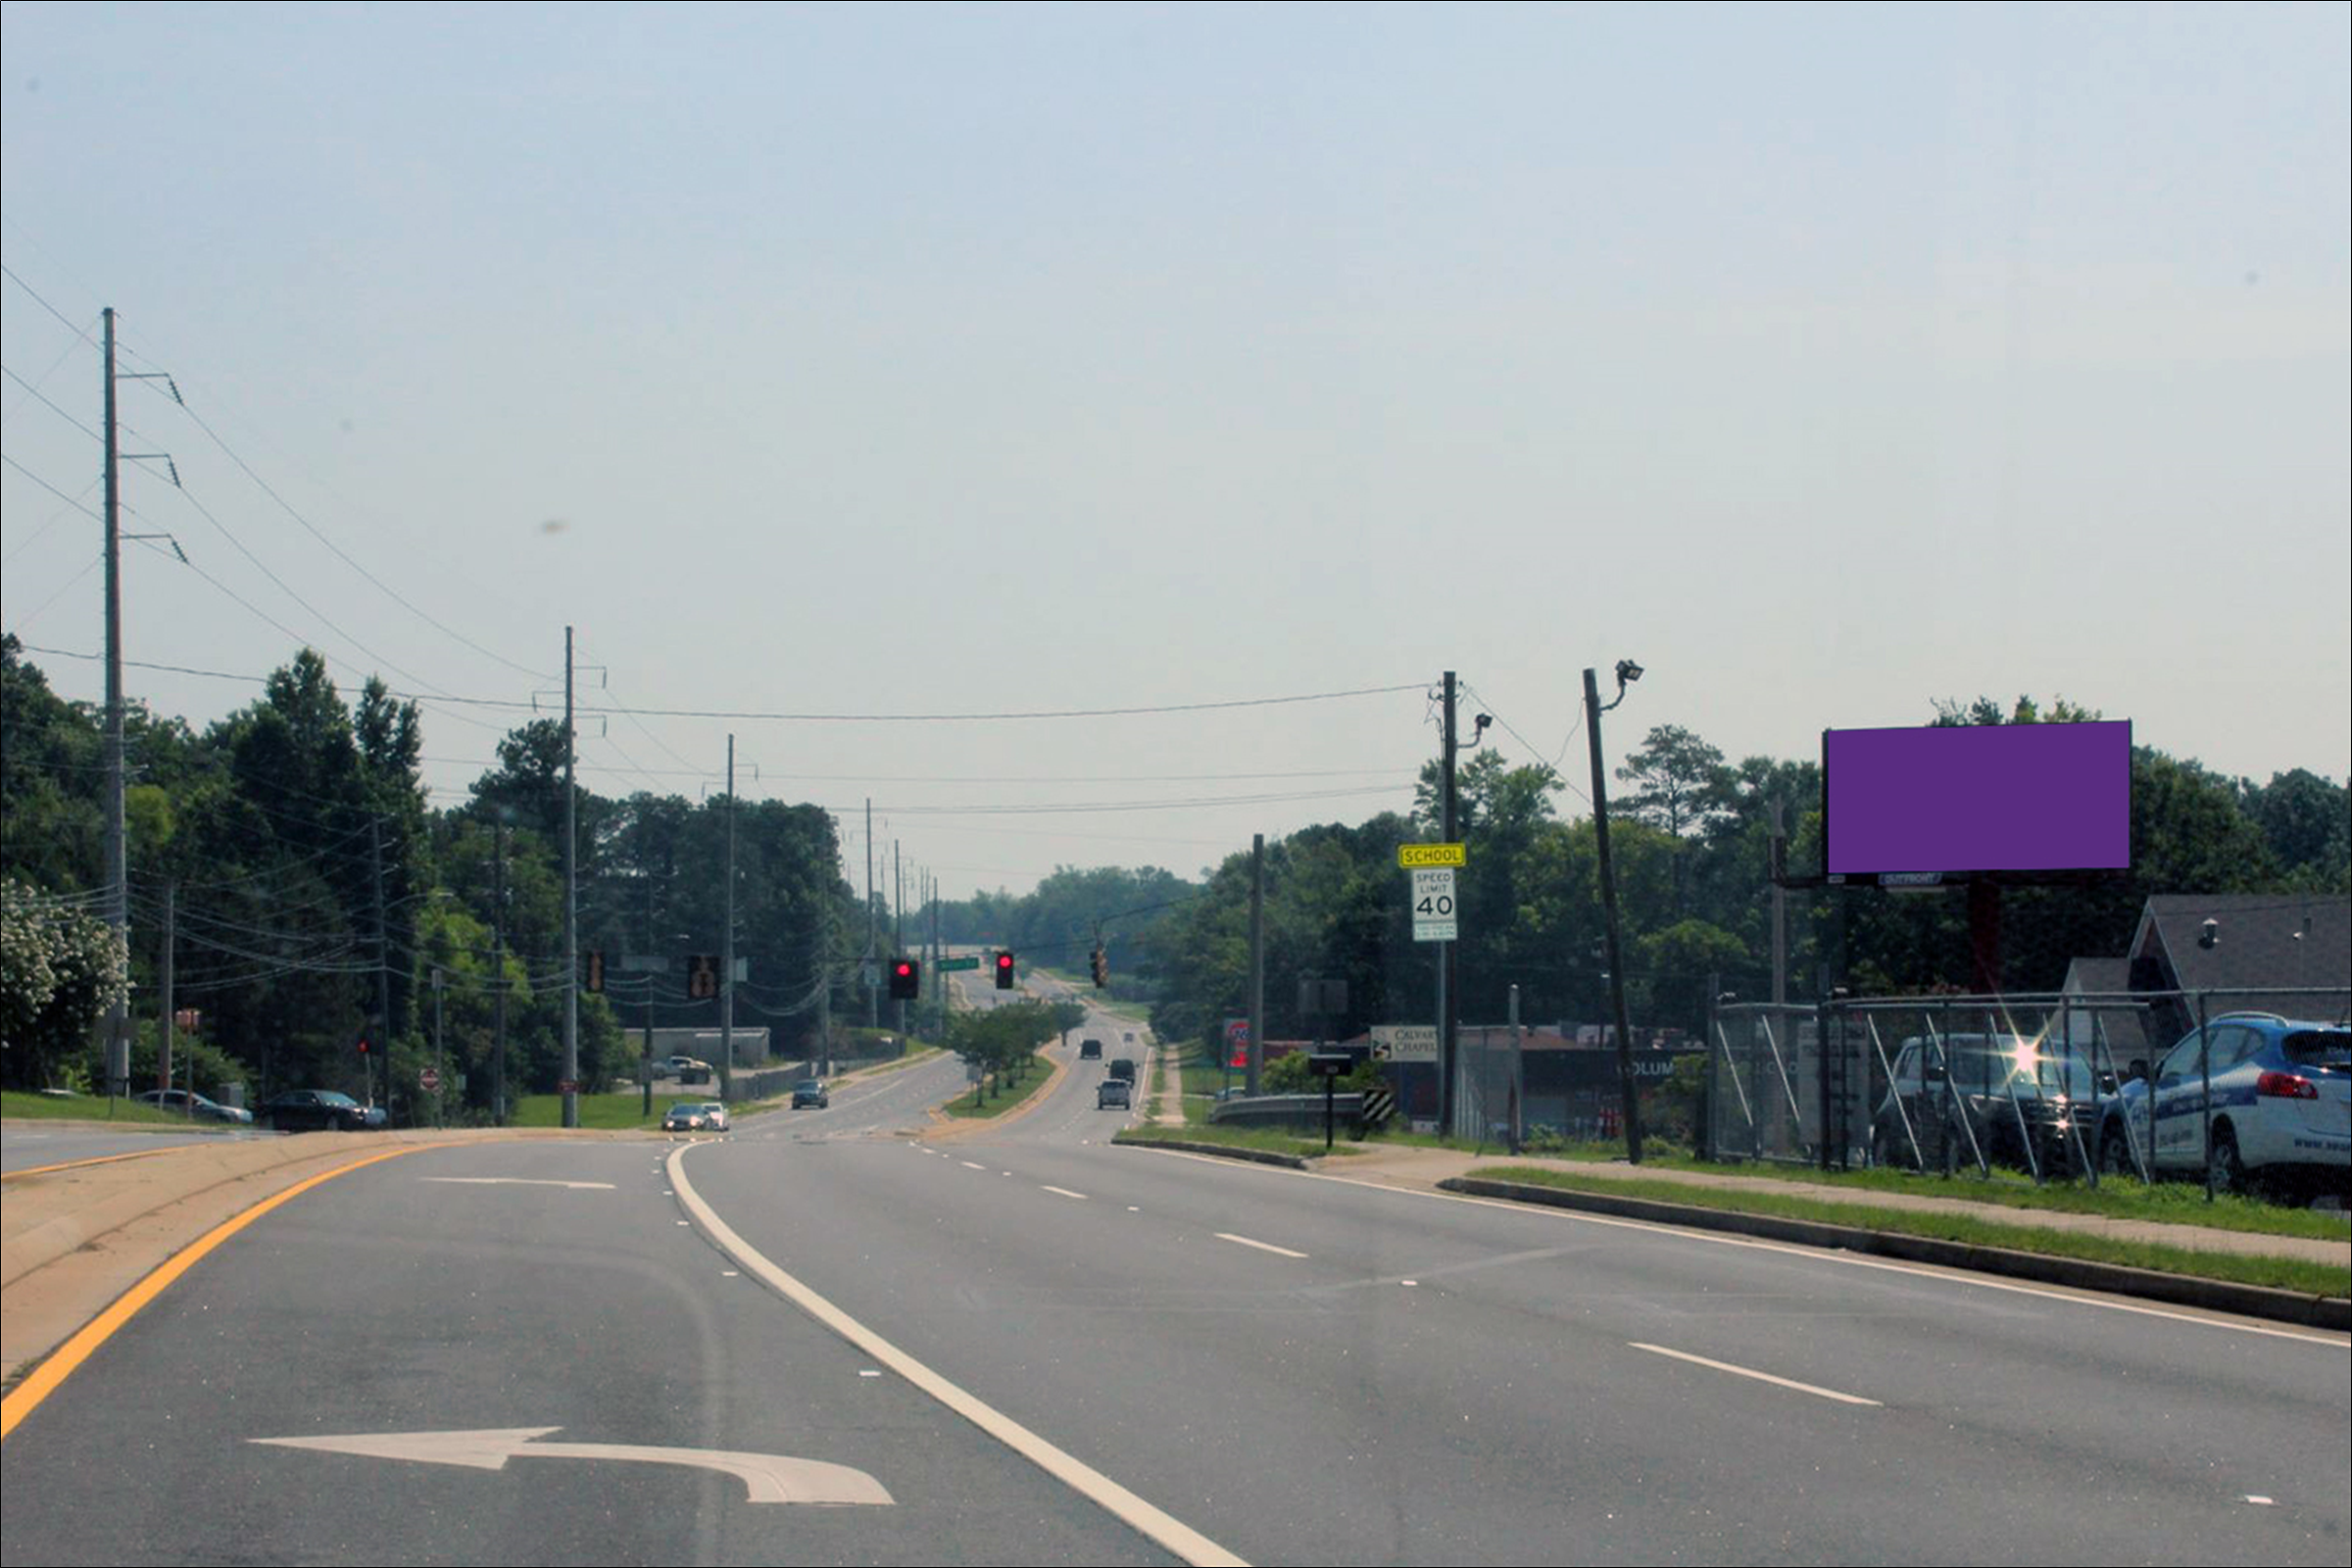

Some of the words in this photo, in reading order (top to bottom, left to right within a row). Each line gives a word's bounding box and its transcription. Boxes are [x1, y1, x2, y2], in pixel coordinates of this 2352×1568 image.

[1404, 849, 1461, 862] SCHOOL
[1415, 872, 1451, 883] SPEED
[1420, 884, 1447, 894] LIMIT
[1416, 895, 1452, 915] 40
